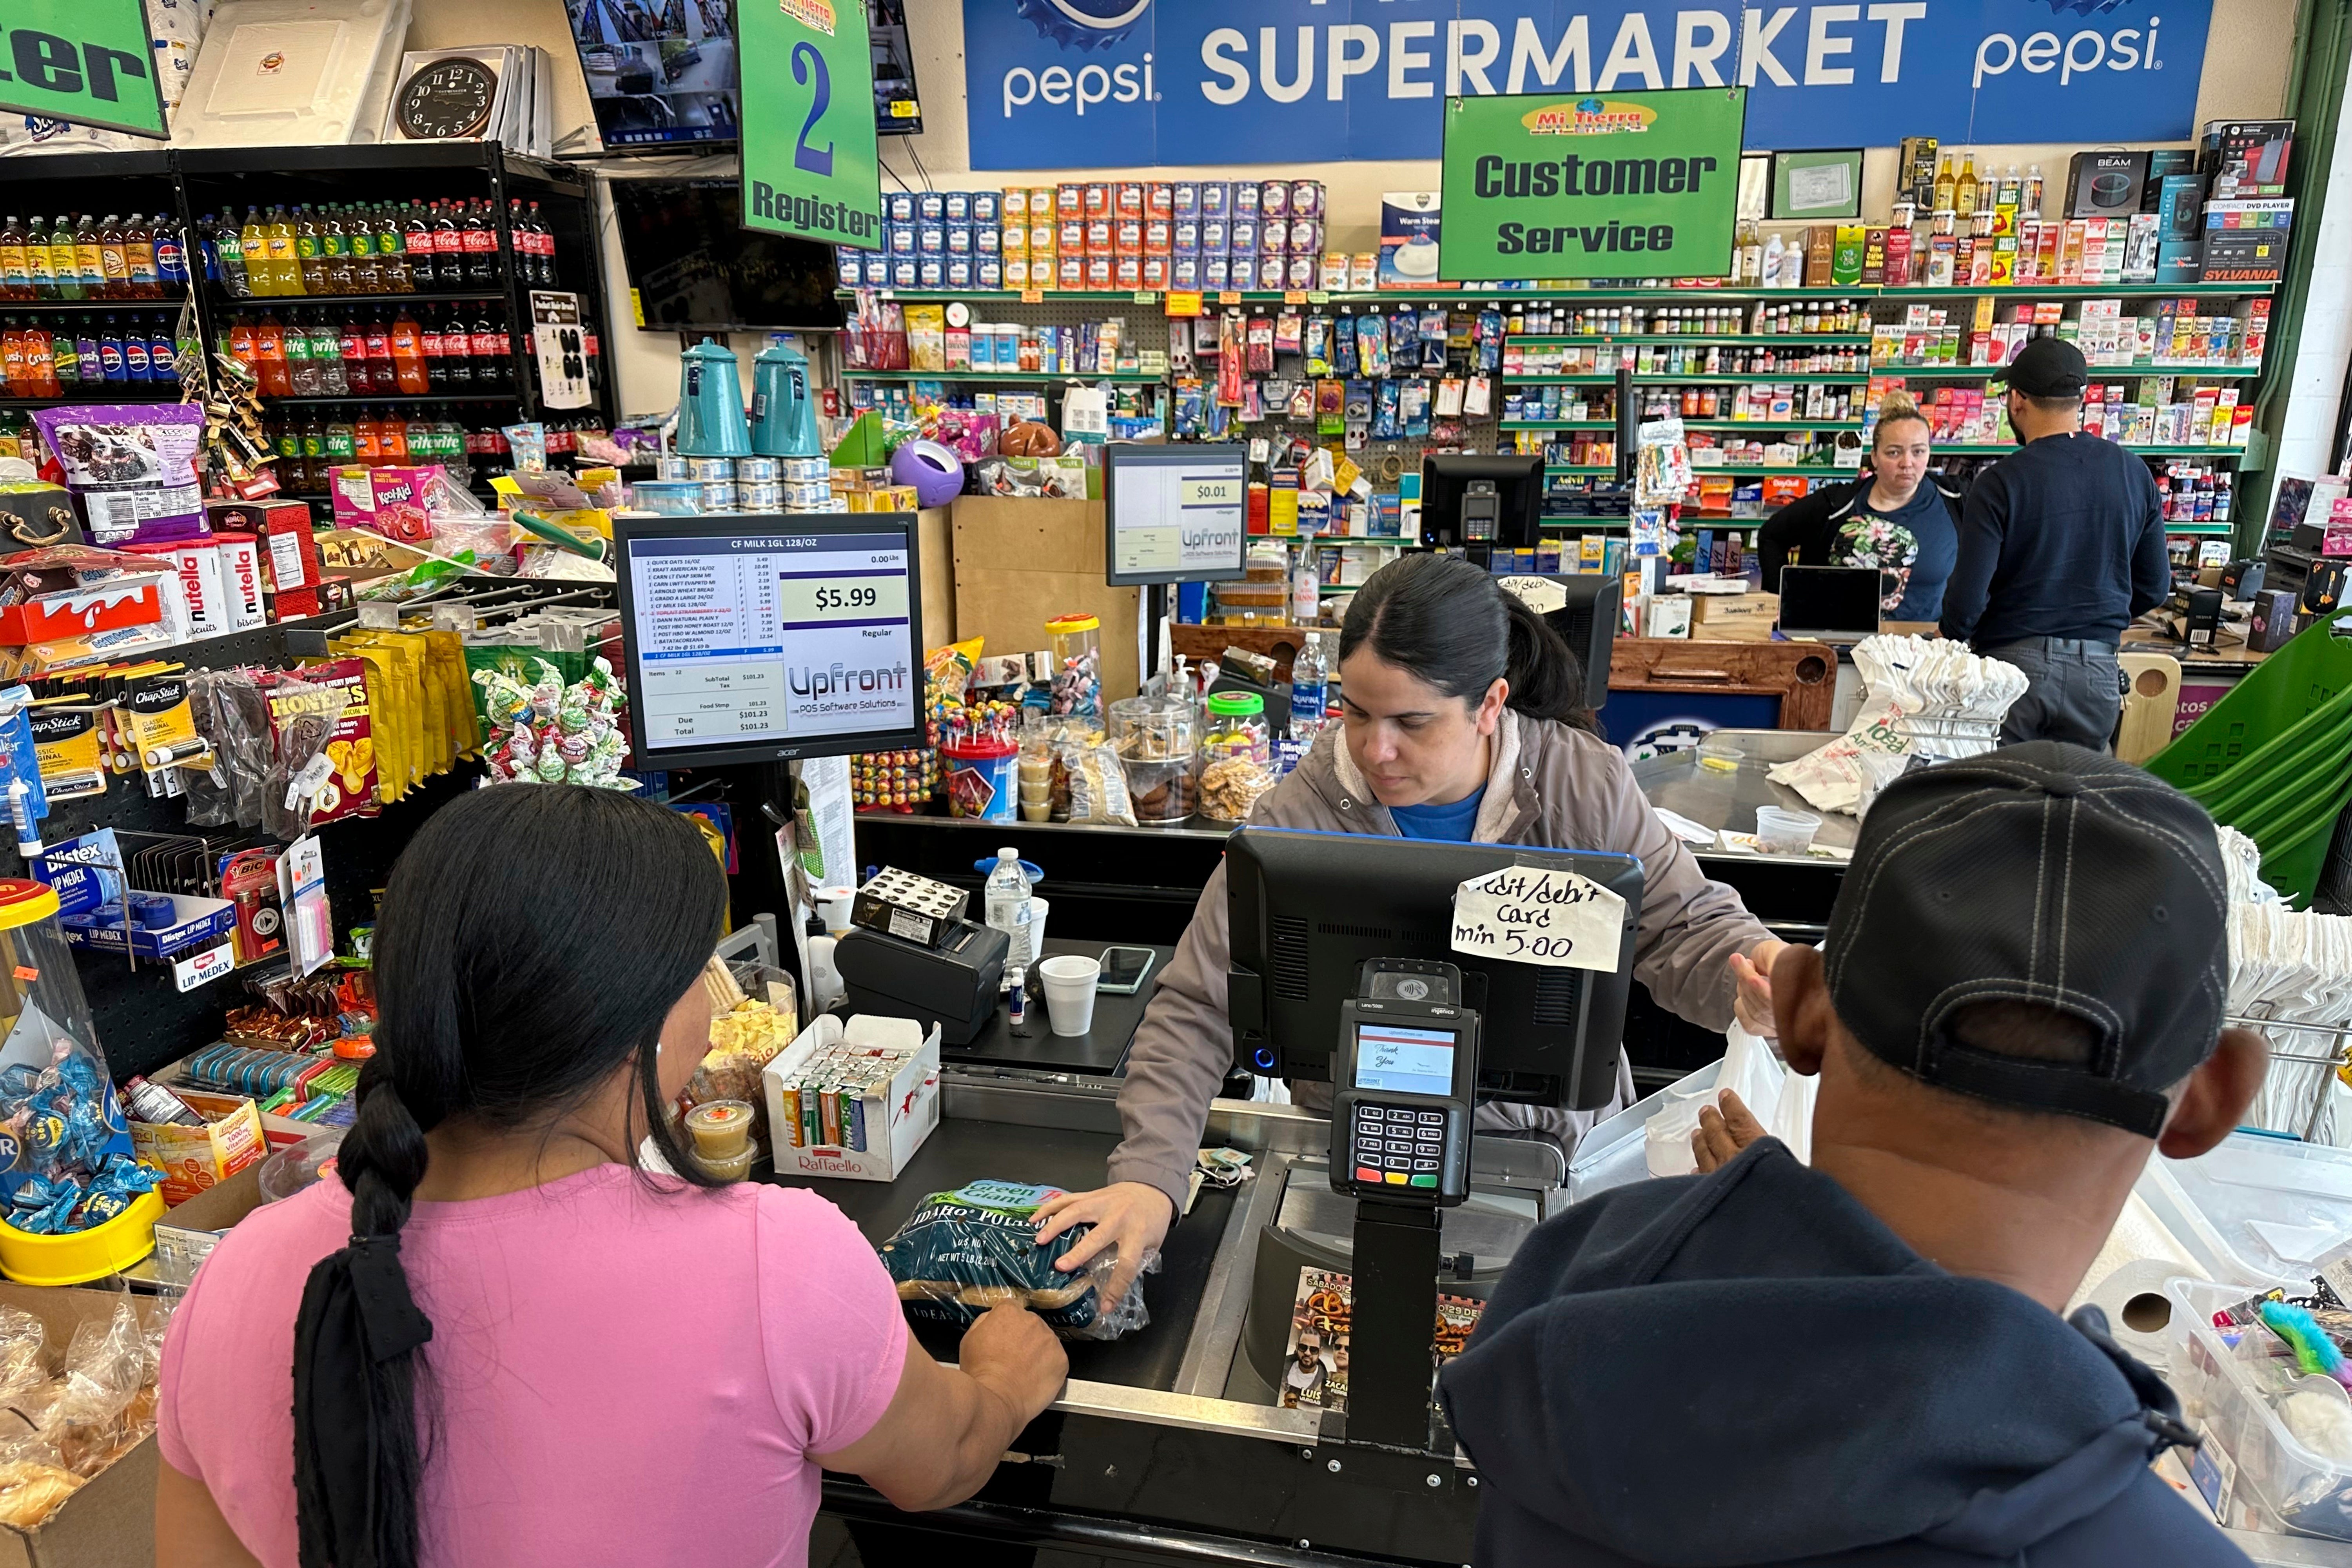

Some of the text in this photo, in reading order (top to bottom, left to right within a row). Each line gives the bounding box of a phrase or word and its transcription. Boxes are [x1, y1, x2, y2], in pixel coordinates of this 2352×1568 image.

[1200, 3, 1926, 105] SUPERMARKET
[1973, 16, 2158, 88] pepsi
[0, 23, 146, 102] er
[432, 74, 443, 85] 11
[448, 69, 463, 80] 12
[466, 73, 473, 83] 1
[416, 85, 430, 97] 10
[474, 83, 484, 94] 2
[1002, 53, 1153, 118] pepsi
[411, 99, 420, 110] 9
[476, 96, 486, 107] 3
[467, 110, 476, 121] 4
[791, 41, 833, 177] 2
[413, 114, 423, 125] 8
[1538, 111, 1640, 125] Mi Tierra
[424, 123, 432, 134] 7
[437, 125, 446, 136] 6
[454, 121, 463, 132] 5
[2098, 159, 2131, 167] BEAM
[1475, 154, 1717, 198] Customer
[753, 180, 878, 238] Register
[1497, 220, 1673, 254] Service
[2203, 270, 2278, 281] SYLVANIA
[1557, 475, 1584, 485] Advil
[377, 483, 412, 505] Kool-Aid
[1197, 486, 1226, 499] $0.01
[744, 540, 766, 548] MILK
[786, 538, 817, 548] 128/OZ
[1182, 528, 1238, 550] Upfront
[235, 551, 257, 613] nutella
[178, 557, 205, 621] nutella
[816, 587, 876, 611] $5.99
[237, 615, 264, 627] biscuits
[862, 629, 892, 638] Regular
[327, 679, 344, 688] EVERY
[345, 676, 361, 684] DROP
[789, 661, 907, 701] Upfront
[136, 685, 180, 704] ChapStick
[800, 700, 896, 713] POS Software Solutions
[739, 711, 768, 719] $101.23
[31, 715, 81, 733] apStick
[143, 723, 169, 733] ORIGINAL
[51, 783, 92, 795] ChapStick
[46, 842, 102, 873] Blistex
[240, 860, 265, 875] BIC
[51, 867, 87, 891] LIP MEDEX
[1476, 874, 1601, 904] edit/debit
[89, 929, 122, 941] LIP MEDEX
[162, 931, 186, 943] Blistex
[196, 917, 211, 931] MEDEX
[1455, 924, 1573, 958] min 5.00
[182, 960, 230, 988] LIP MEDEX
[1374, 1044, 1398, 1055] Thank
[1376, 1056, 1394, 1068] You
[226, 1133, 248, 1151] Vitamin
[799, 1156, 861, 1172] Raffaello
[970, 1183, 1036, 1196] Green
[964, 1189, 1023, 1205] Giant
[950, 1253, 960, 1262] WT
[961, 1253, 965, 1261] 5
[966, 1254, 975, 1263] LB
[1450, 1306, 1477, 1317] 29 DE
[1301, 1388, 1321, 1399] LUIS
[1299, 1396, 1321, 1405] VARGAS
